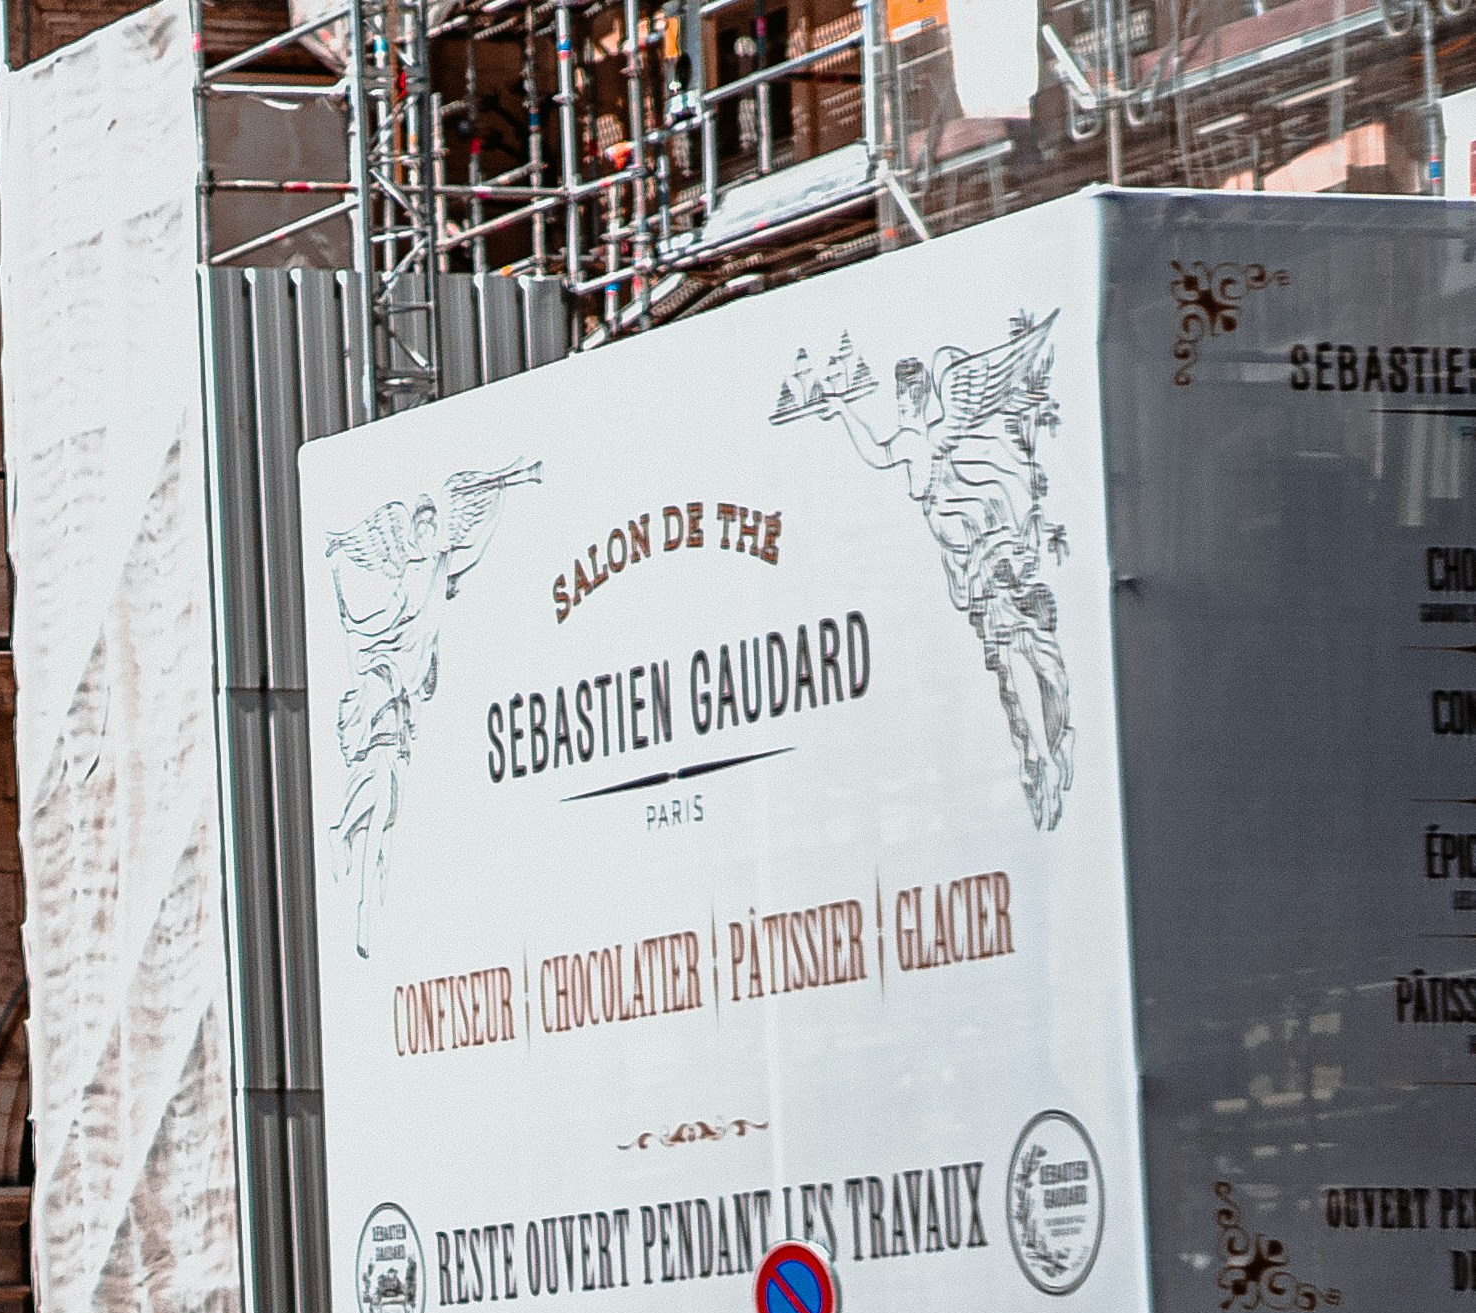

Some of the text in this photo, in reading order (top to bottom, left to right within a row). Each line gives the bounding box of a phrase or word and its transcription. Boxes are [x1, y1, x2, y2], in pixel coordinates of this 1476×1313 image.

[553, 512, 651, 624] SALON
[663, 502, 704, 552] DE
[690, 610, 870, 735] GAUDARD
[646, 795, 705, 830] PARIS
[394, 871, 1015, 1057] CONFISEUR CHOCOLATIER PÂTISSIER GLACIER
[436, 1222, 519, 1306] RESTE
[526, 1207, 630, 1296] OUVERT
[640, 1189, 771, 1285] PENDANT
[844, 1161, 988, 1261] TRAVAUX
[1326, 1188, 1428, 1229] OUVERT
